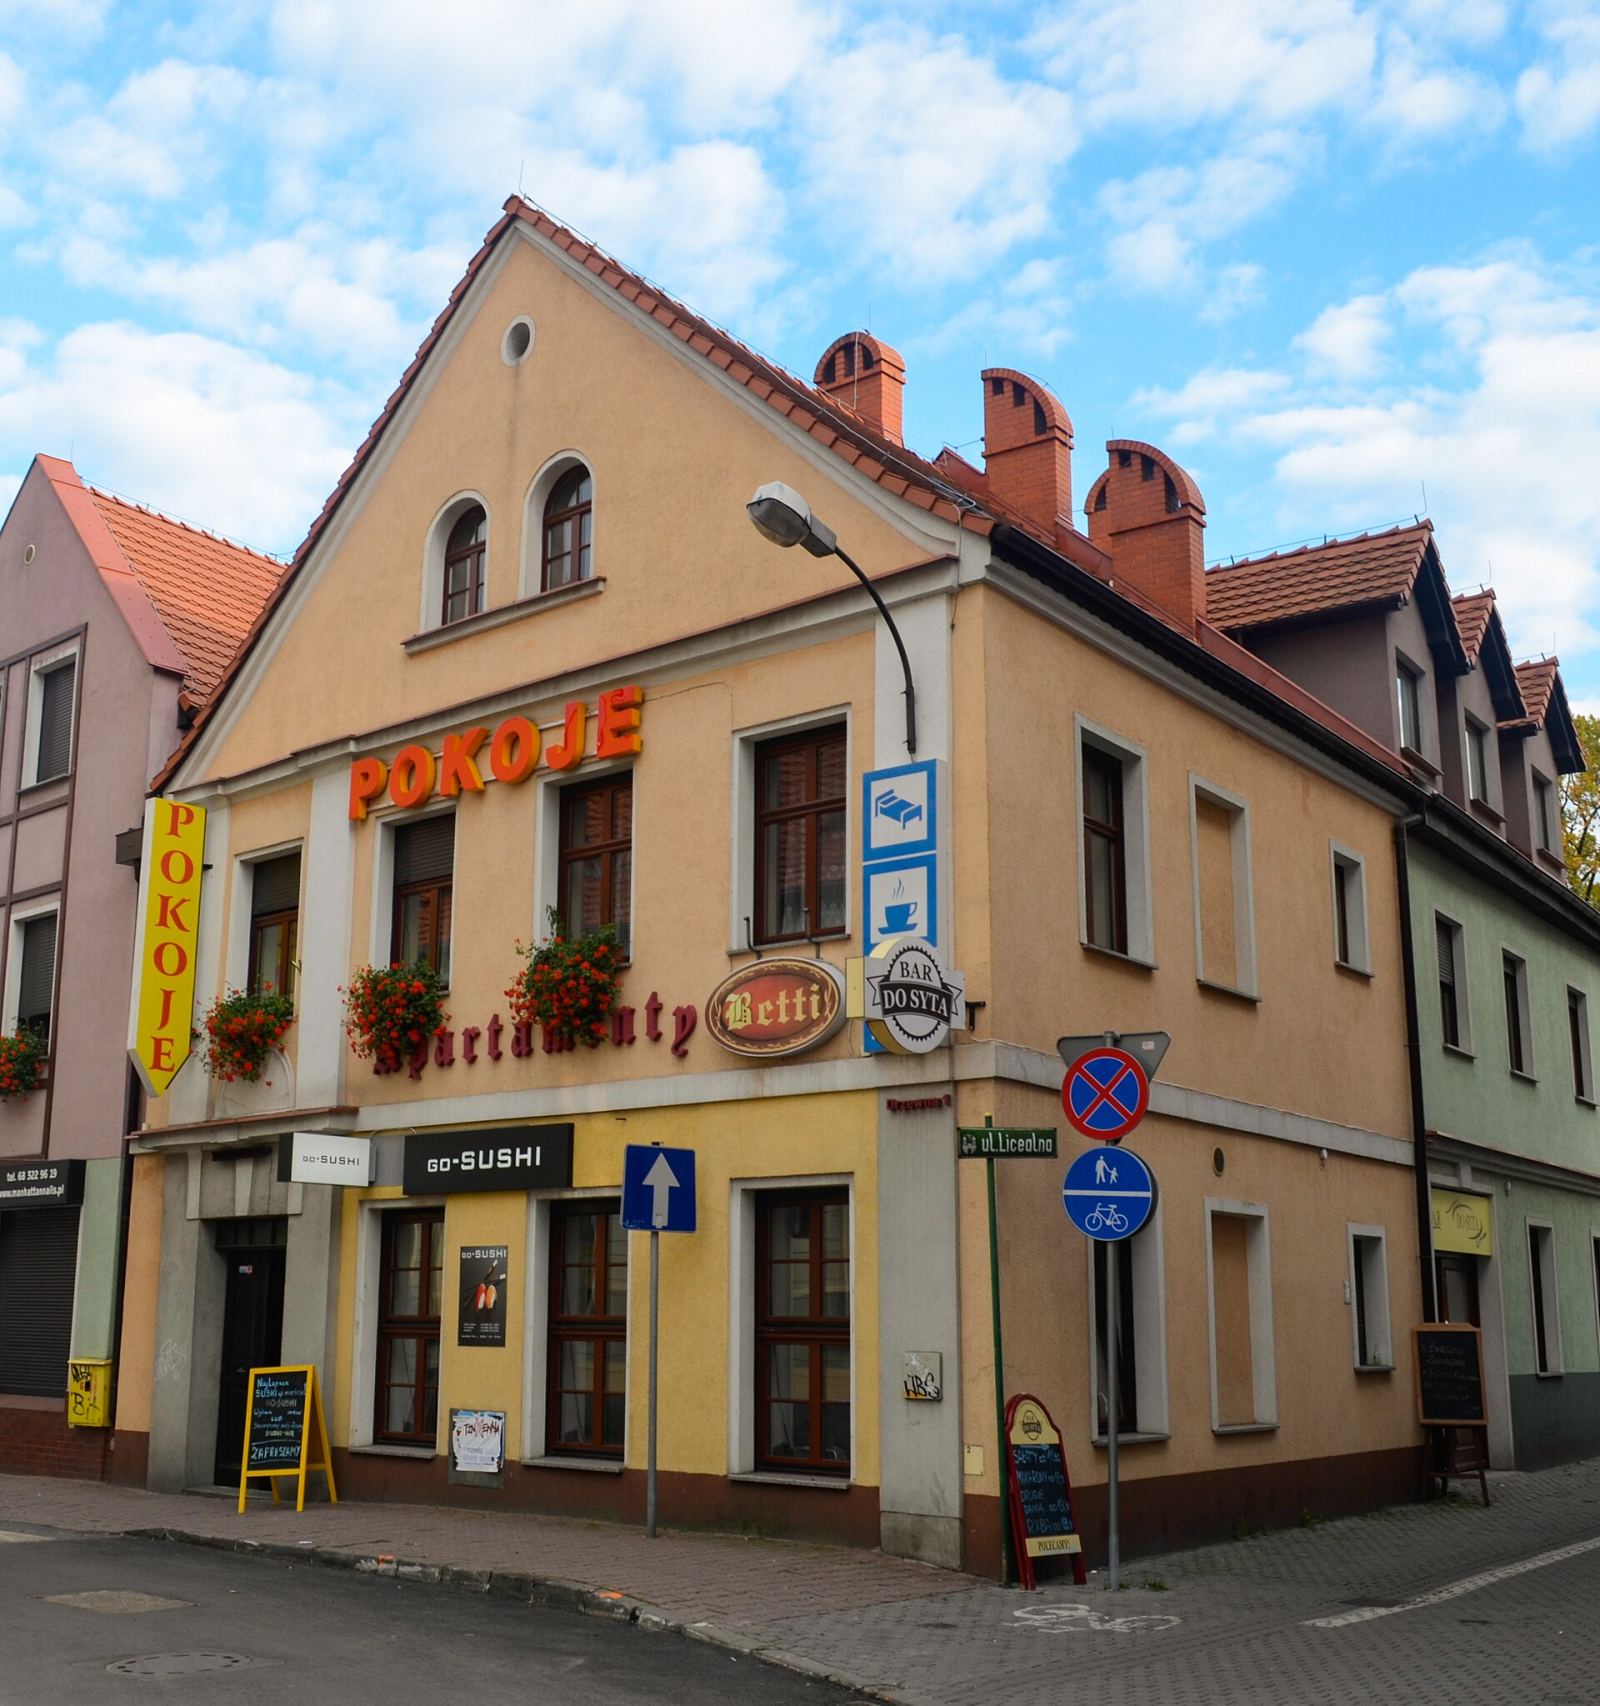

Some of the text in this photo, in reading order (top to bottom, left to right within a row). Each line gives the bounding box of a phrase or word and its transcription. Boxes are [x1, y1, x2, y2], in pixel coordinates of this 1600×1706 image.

[349, 685, 645, 820] POKOJE
[149, 803, 195, 1073] POKOJE
[900, 961, 932, 982] BAR
[725, 983, 820, 1030] Betti
[883, 989, 949, 1017] DO SYTA
[302, 1154, 361, 1167] GO-SUSHI
[427, 1145, 542, 1173] GO-SUSHI
[7, 1172, 17, 1182] tel.
[27, 1170, 39, 1180] 322
[40, 1169, 48, 1179] 96
[50, 1168, 58, 1178] 19
[255, 1389, 278, 1398] SUSHI
[250, 1446, 301, 1460] ZAPRASZAMY
